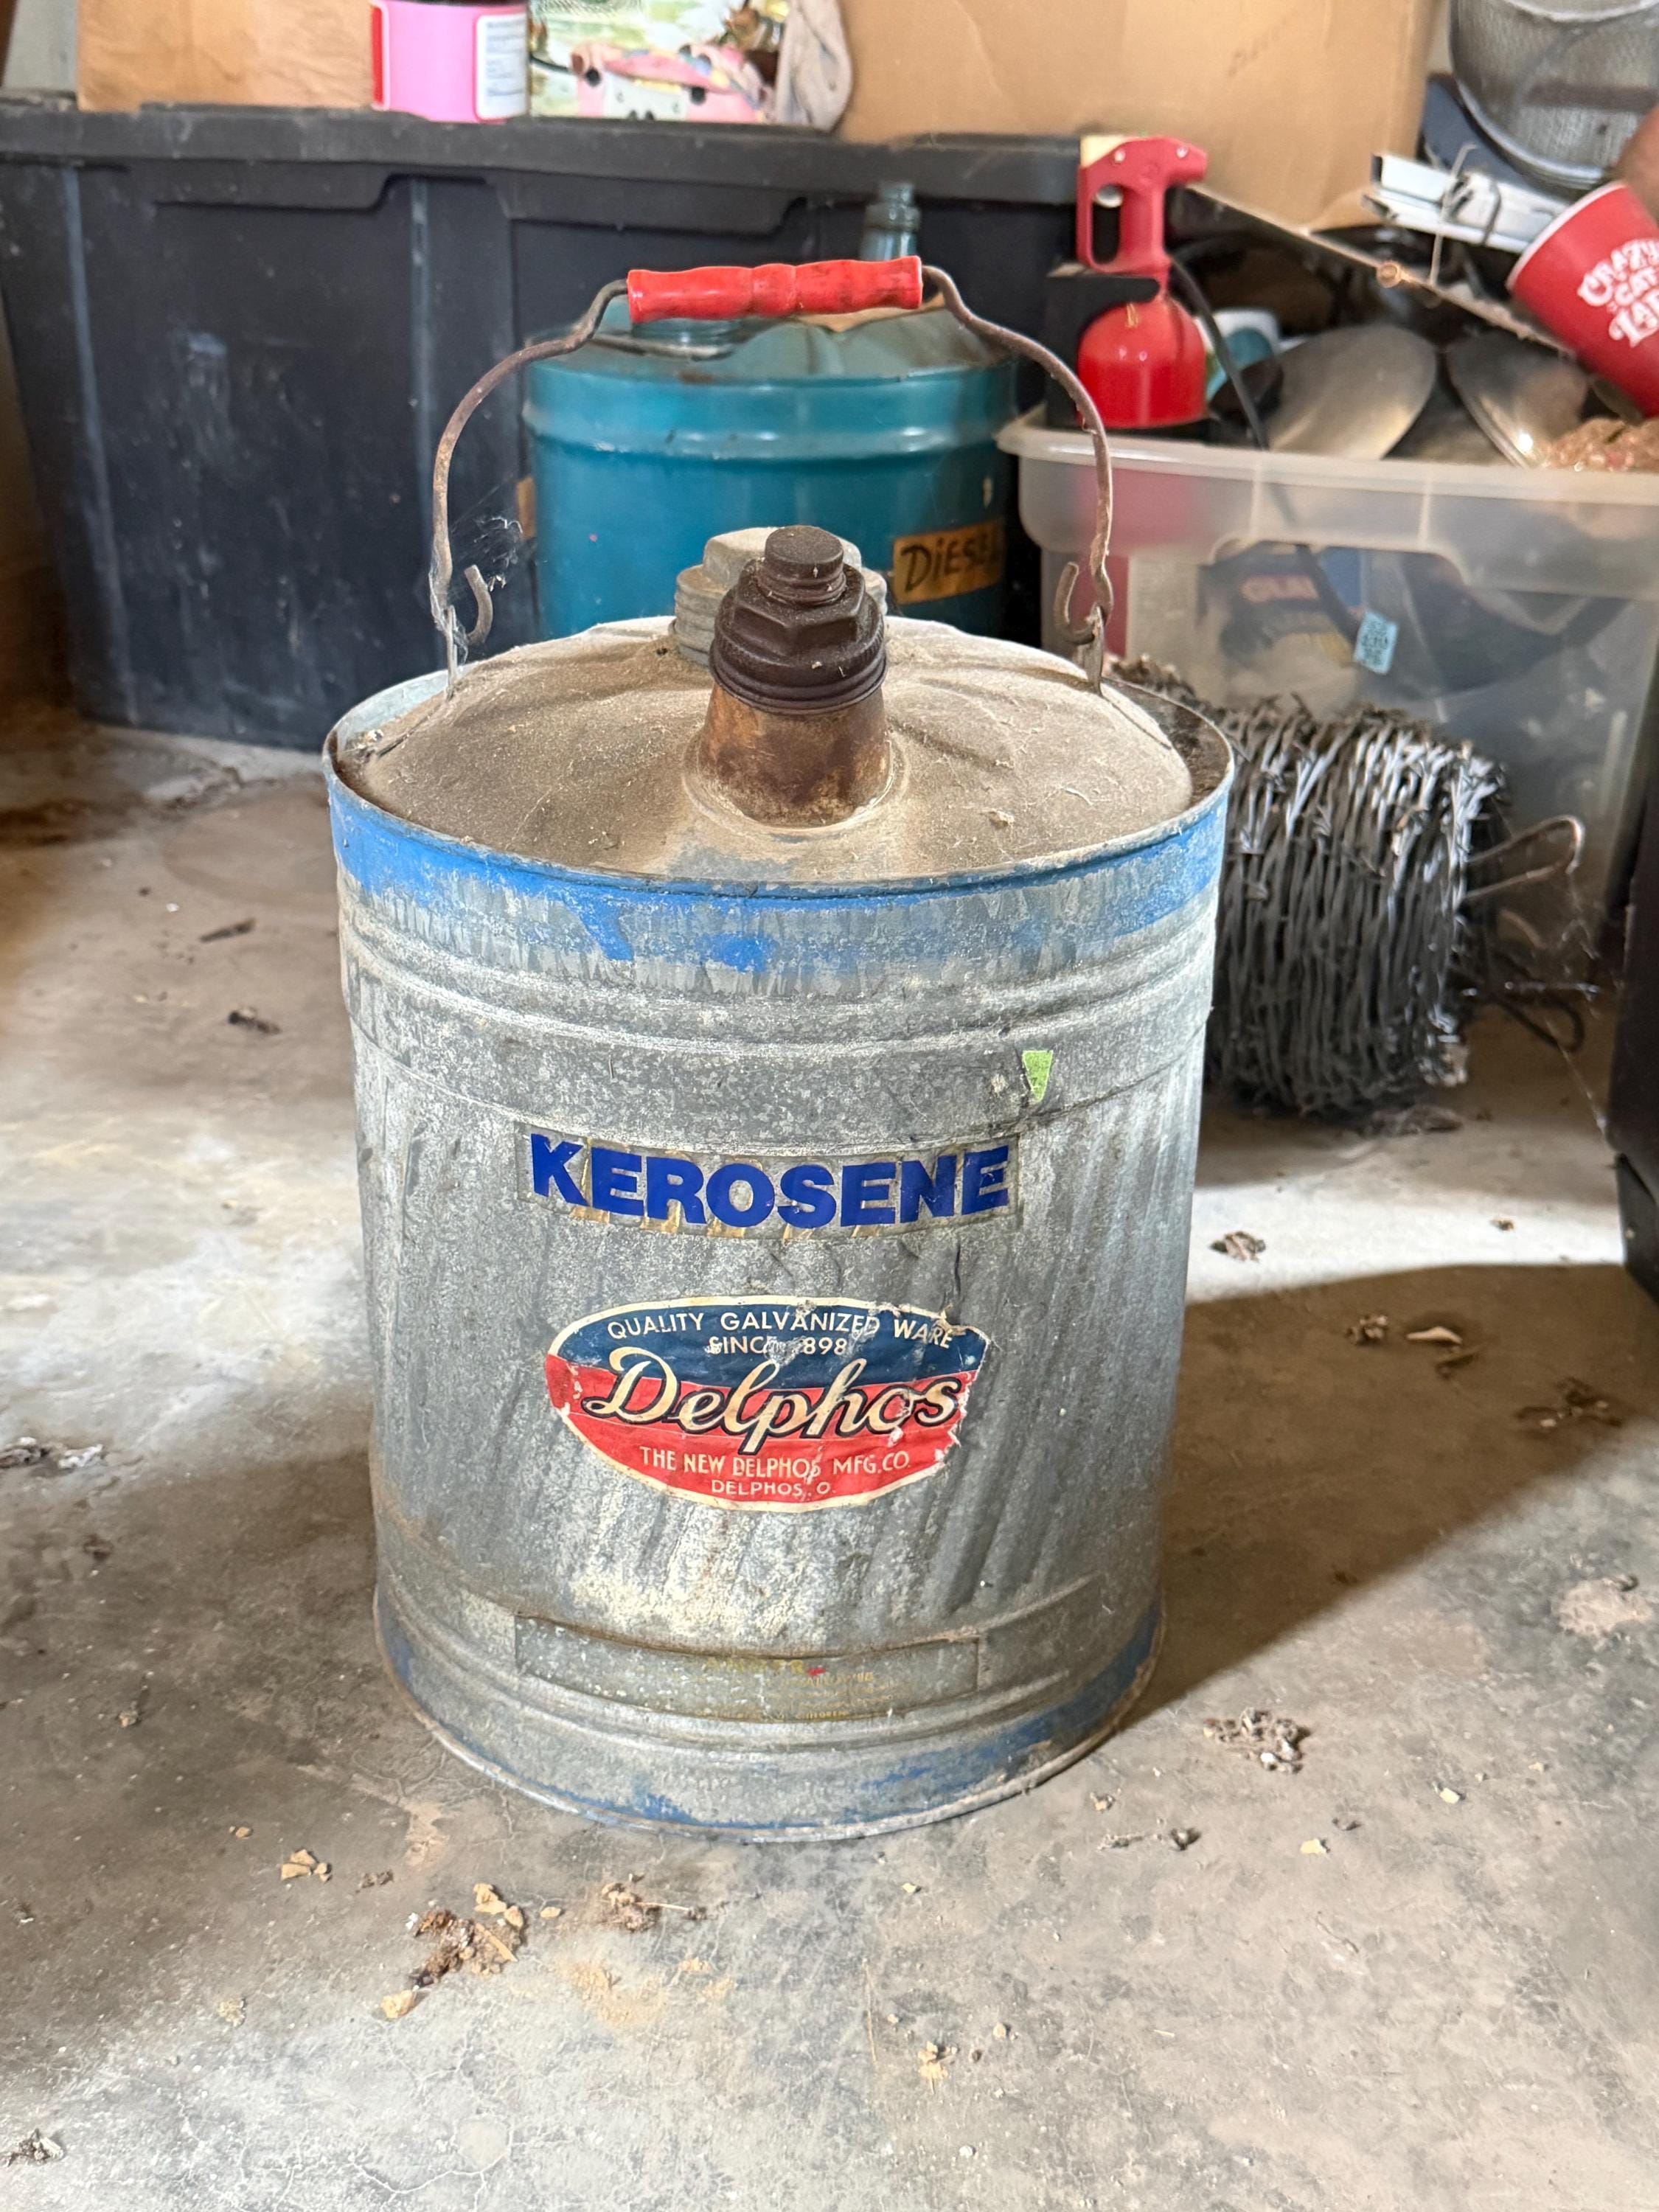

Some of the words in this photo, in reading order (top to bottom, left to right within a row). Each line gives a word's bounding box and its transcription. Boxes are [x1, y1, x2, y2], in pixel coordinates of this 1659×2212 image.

[530, 1133, 1009, 1228] KEROSENE
[607, 1312, 704, 1340] QUALITY
[720, 1310, 880, 1335] GALVANIZED
[893, 1318, 953, 1349] WARE
[795, 1337, 848, 1355] 898
[582, 1346, 962, 1455] Delphos
[639, 1446, 676, 1471] THE
[684, 1453, 726, 1475] NEW
[733, 1455, 821, 1479] DELPHOS
